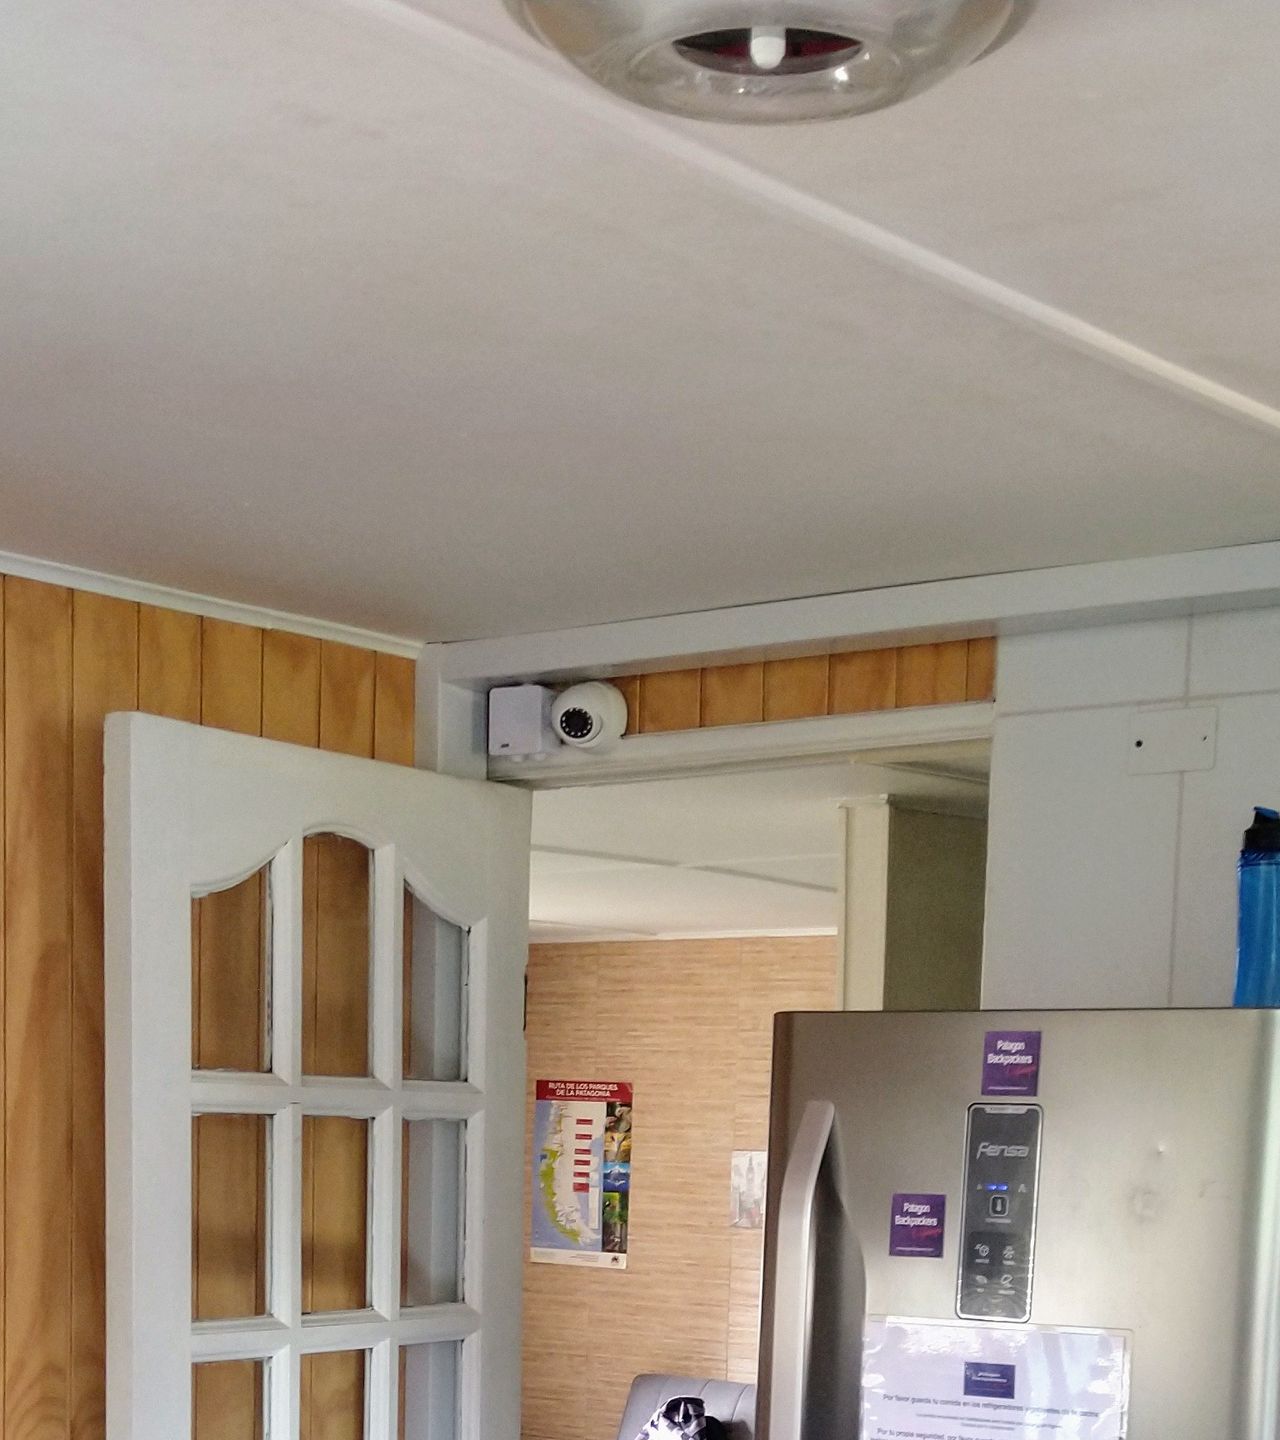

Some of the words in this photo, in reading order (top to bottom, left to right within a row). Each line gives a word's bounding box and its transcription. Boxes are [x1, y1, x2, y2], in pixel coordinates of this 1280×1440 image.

[997, 1040, 1025, 1052] Patagon
[987, 1053, 1032, 1065] Backpackers
[903, 1203, 930, 1215] Patagon
[895, 1215, 937, 1228] Backpackers
